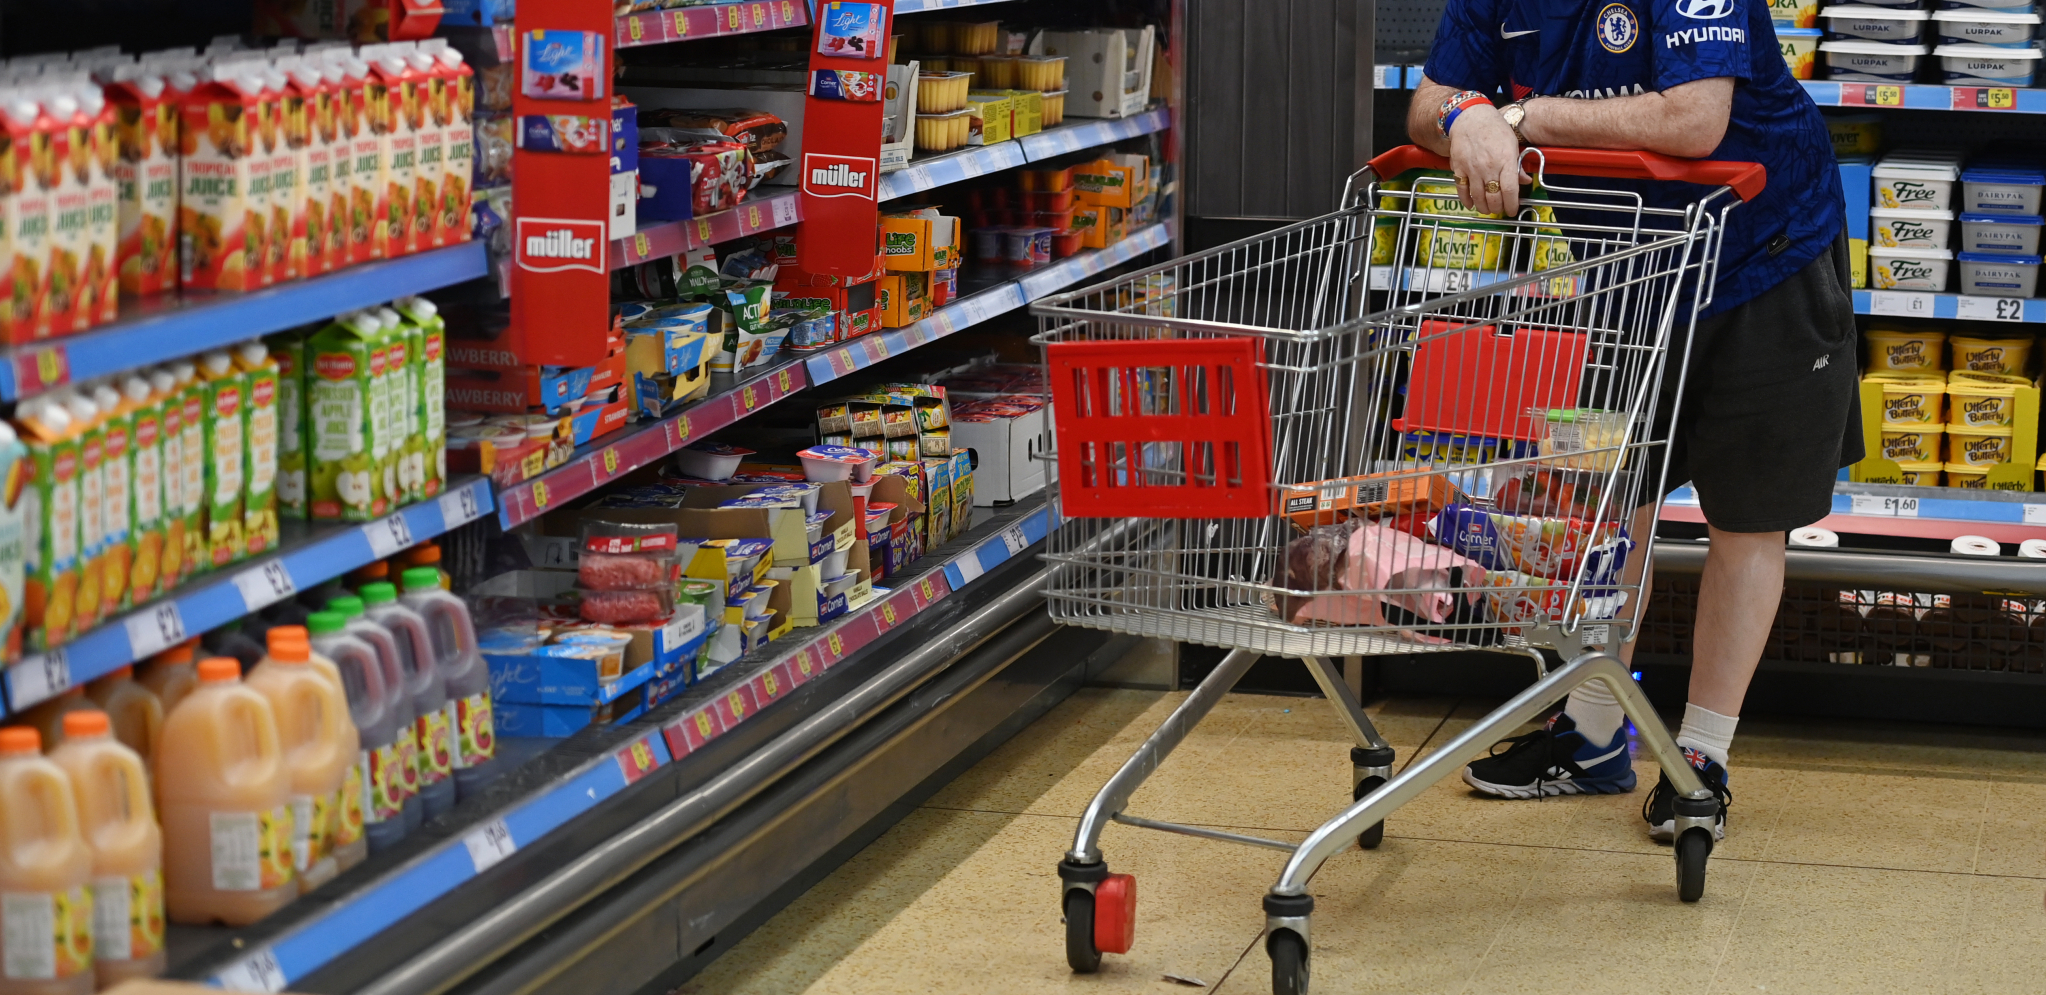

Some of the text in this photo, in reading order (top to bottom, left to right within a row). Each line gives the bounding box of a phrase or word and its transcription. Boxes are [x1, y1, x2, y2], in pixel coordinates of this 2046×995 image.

[1603, 7, 1628, 19] CHELSEA
[832, 13, 865, 31] Light
[1853, 23, 1889, 32] LURPAK
[1665, 26, 1745, 49] HYUNDAI
[1965, 28, 2002, 36] LURPAK
[1852, 58, 1888, 66] LURPAK
[1967, 62, 2004, 71] LURPAK
[1879, 90, 1897, 101] £5.50
[1991, 93, 2009, 104] £5.50
[419, 145, 441, 166] JUICE
[447, 142, 470, 161] JUICE
[354, 154, 378, 174] JUICE
[391, 150, 414, 170] JUICE
[308, 165, 329, 185] JUICE
[811, 164, 867, 188] müller
[186, 177, 237, 196] JUICE
[1893, 182, 1936, 199] Free
[1978, 191, 2024, 200] DAIRYPAK
[1891, 221, 1934, 238] Free
[1976, 231, 2023, 240] DAIRYPAK
[526, 229, 595, 259] müller
[1429, 239, 1479, 255] Clover
[1890, 260, 1933, 278] Free
[1975, 270, 2021, 278] DAIRYPAK
[1446, 271, 1471, 291] £4
[1913, 300, 1922, 310] £1
[1996, 299, 2021, 320] £2
[1887, 342, 1922, 356] Utterly
[1966, 350, 2001, 363] Utterly
[1812, 354, 1830, 372] AIR
[1891, 354, 1926, 365] Butterly
[1970, 361, 2005, 372] Butterly
[1885, 396, 1920, 410] Utterly
[1964, 399, 1999, 413] Utterly
[604, 407, 628, 425] STRAWBERRY
[1889, 409, 1924, 419] Butterly
[1969, 412, 2004, 423] Butterly
[1882, 435, 1917, 448] Utterly
[1965, 438, 1999, 451] Utterly
[1887, 447, 1922, 458] Butterly
[1969, 451, 2004, 461] Butterly
[460, 487, 477, 518] £2
[1884, 499, 1917, 516] £1.60
[388, 515, 410, 546] £2
[875, 530, 890, 544] Corner
[1459, 529, 1494, 546] Corner
[817, 539, 834, 555] Corner
[264, 560, 292, 595] £2
[736, 575, 752, 592] Corner
[827, 597, 844, 613] Corner
[156, 604, 182, 643] £2
